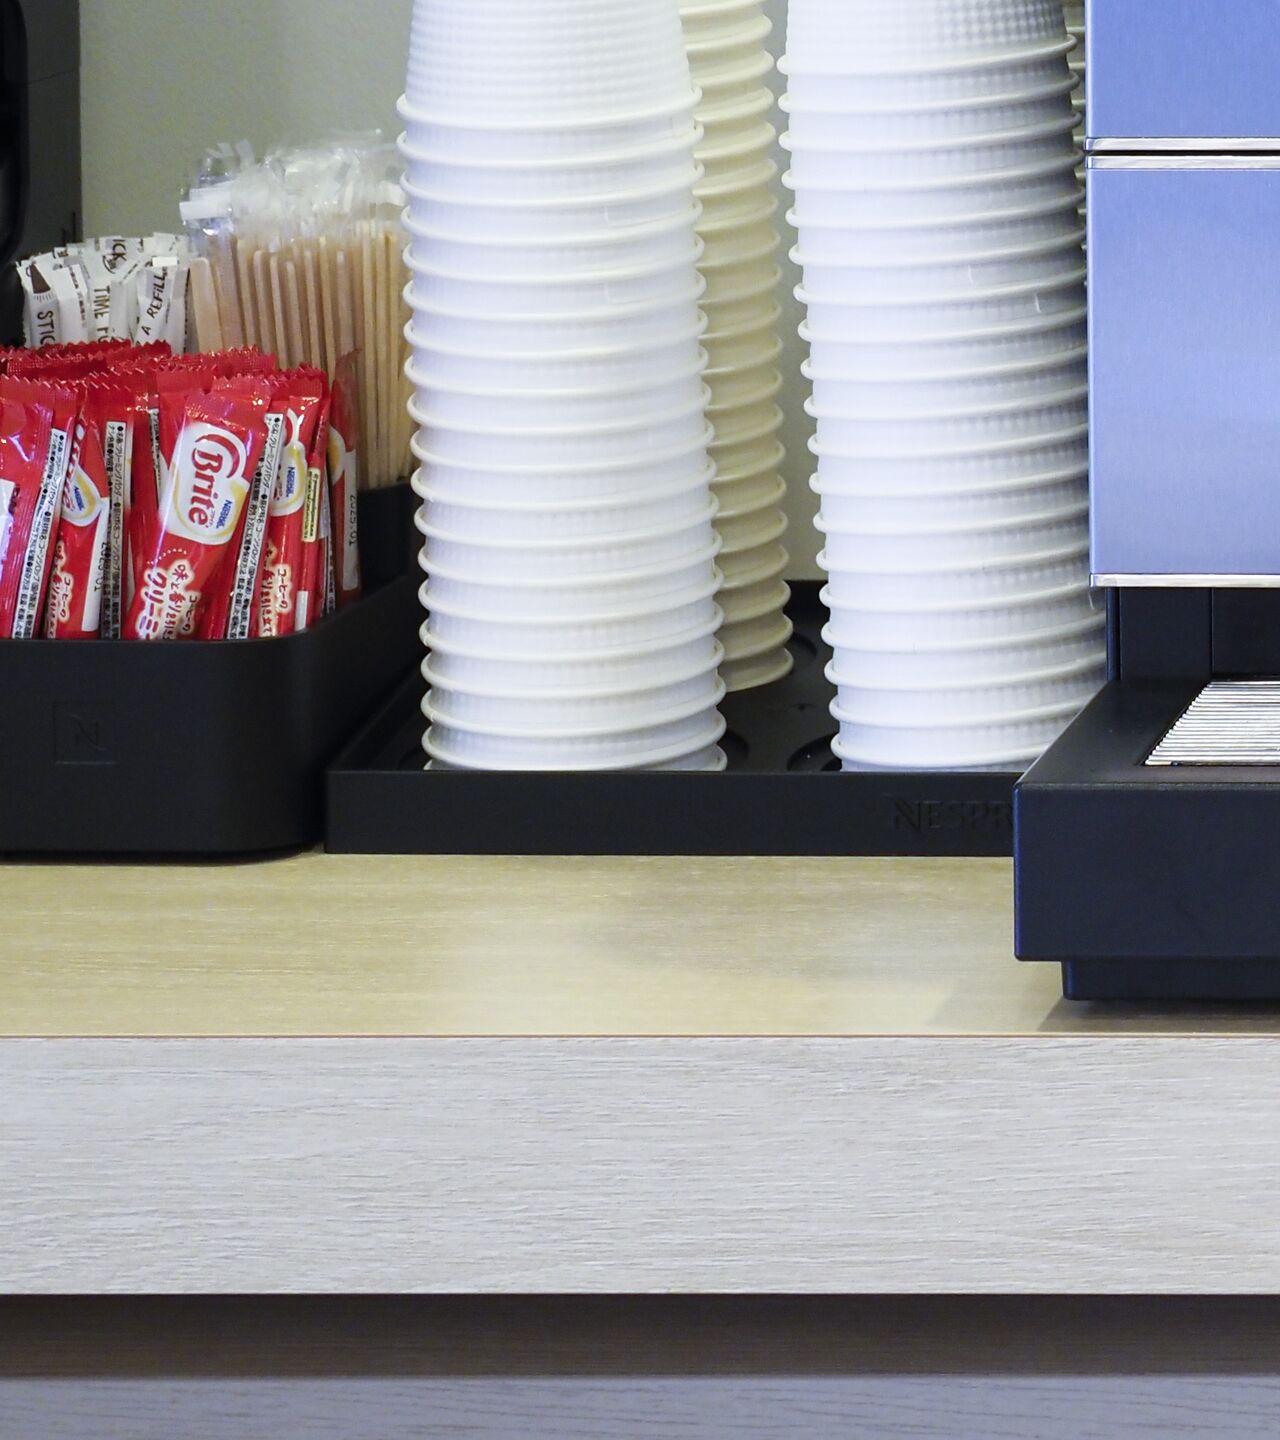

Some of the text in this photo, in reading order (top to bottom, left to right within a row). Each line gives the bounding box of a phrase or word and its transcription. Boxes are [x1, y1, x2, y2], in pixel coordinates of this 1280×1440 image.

[37, 310, 55, 344] STIC
[188, 448, 223, 526] Brite
[139, 571, 168, 640] クリーミ
[883, 794, 1014, 832] NESPR
